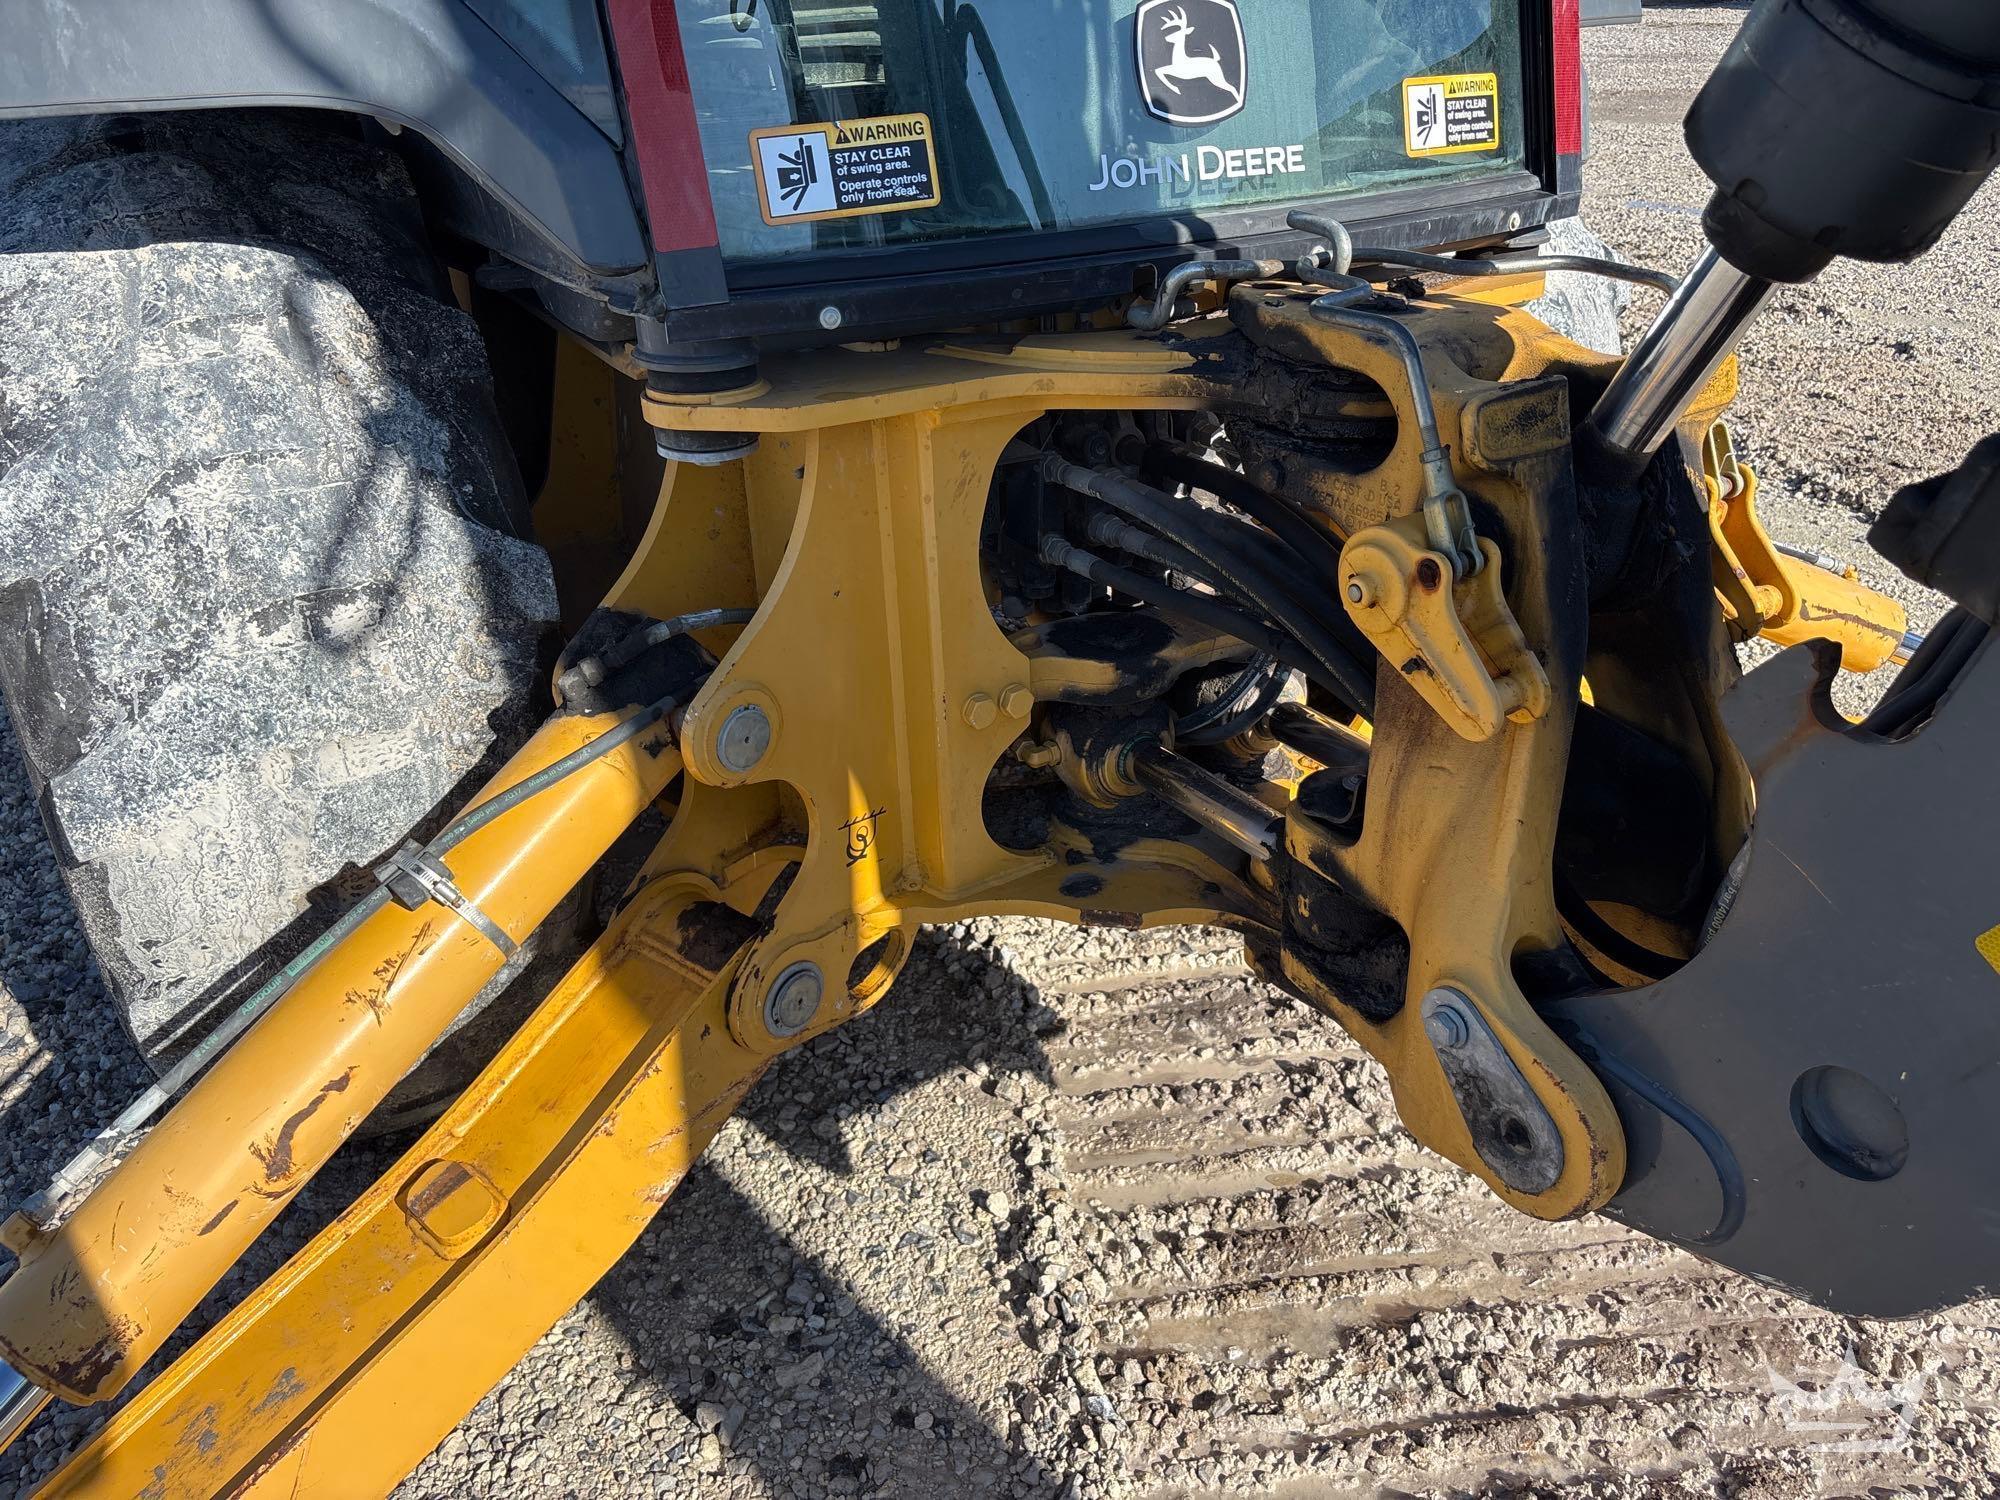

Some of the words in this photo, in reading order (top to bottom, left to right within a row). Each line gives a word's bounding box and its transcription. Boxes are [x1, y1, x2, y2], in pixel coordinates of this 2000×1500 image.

[1456, 80, 1494, 93] WARNING
[1447, 100, 1465, 110] STAY
[1466, 98, 1487, 108] CLEAR
[1447, 112, 1454, 120] of
[1455, 111, 1472, 120] swing
[849, 120, 924, 143] WARNING
[1448, 123, 1470, 133] Operate
[1471, 121, 1494, 130] controls
[1448, 133, 1461, 142] only
[1462, 132, 1476, 140] from
[1476, 130, 1489, 138] seat.
[835, 151, 867, 165] STAY
[870, 146, 911, 160] CLEAR
[837, 165, 849, 176] of
[850, 162, 883, 176] swing
[885, 160, 911, 170] area.
[1089, 153, 1190, 191] JOHN
[1197, 144, 1306, 181] DEERE
[839, 178, 882, 192] Operate
[883, 172, 928, 188] controls
[842, 192, 866, 204] only
[867, 188, 895, 200] from
[527, 772, 549, 788] Made
[556, 758, 574, 772] USA
[1722, 886, 1737, 904] bar
[241, 975, 284, 1016] AEROQUIP
